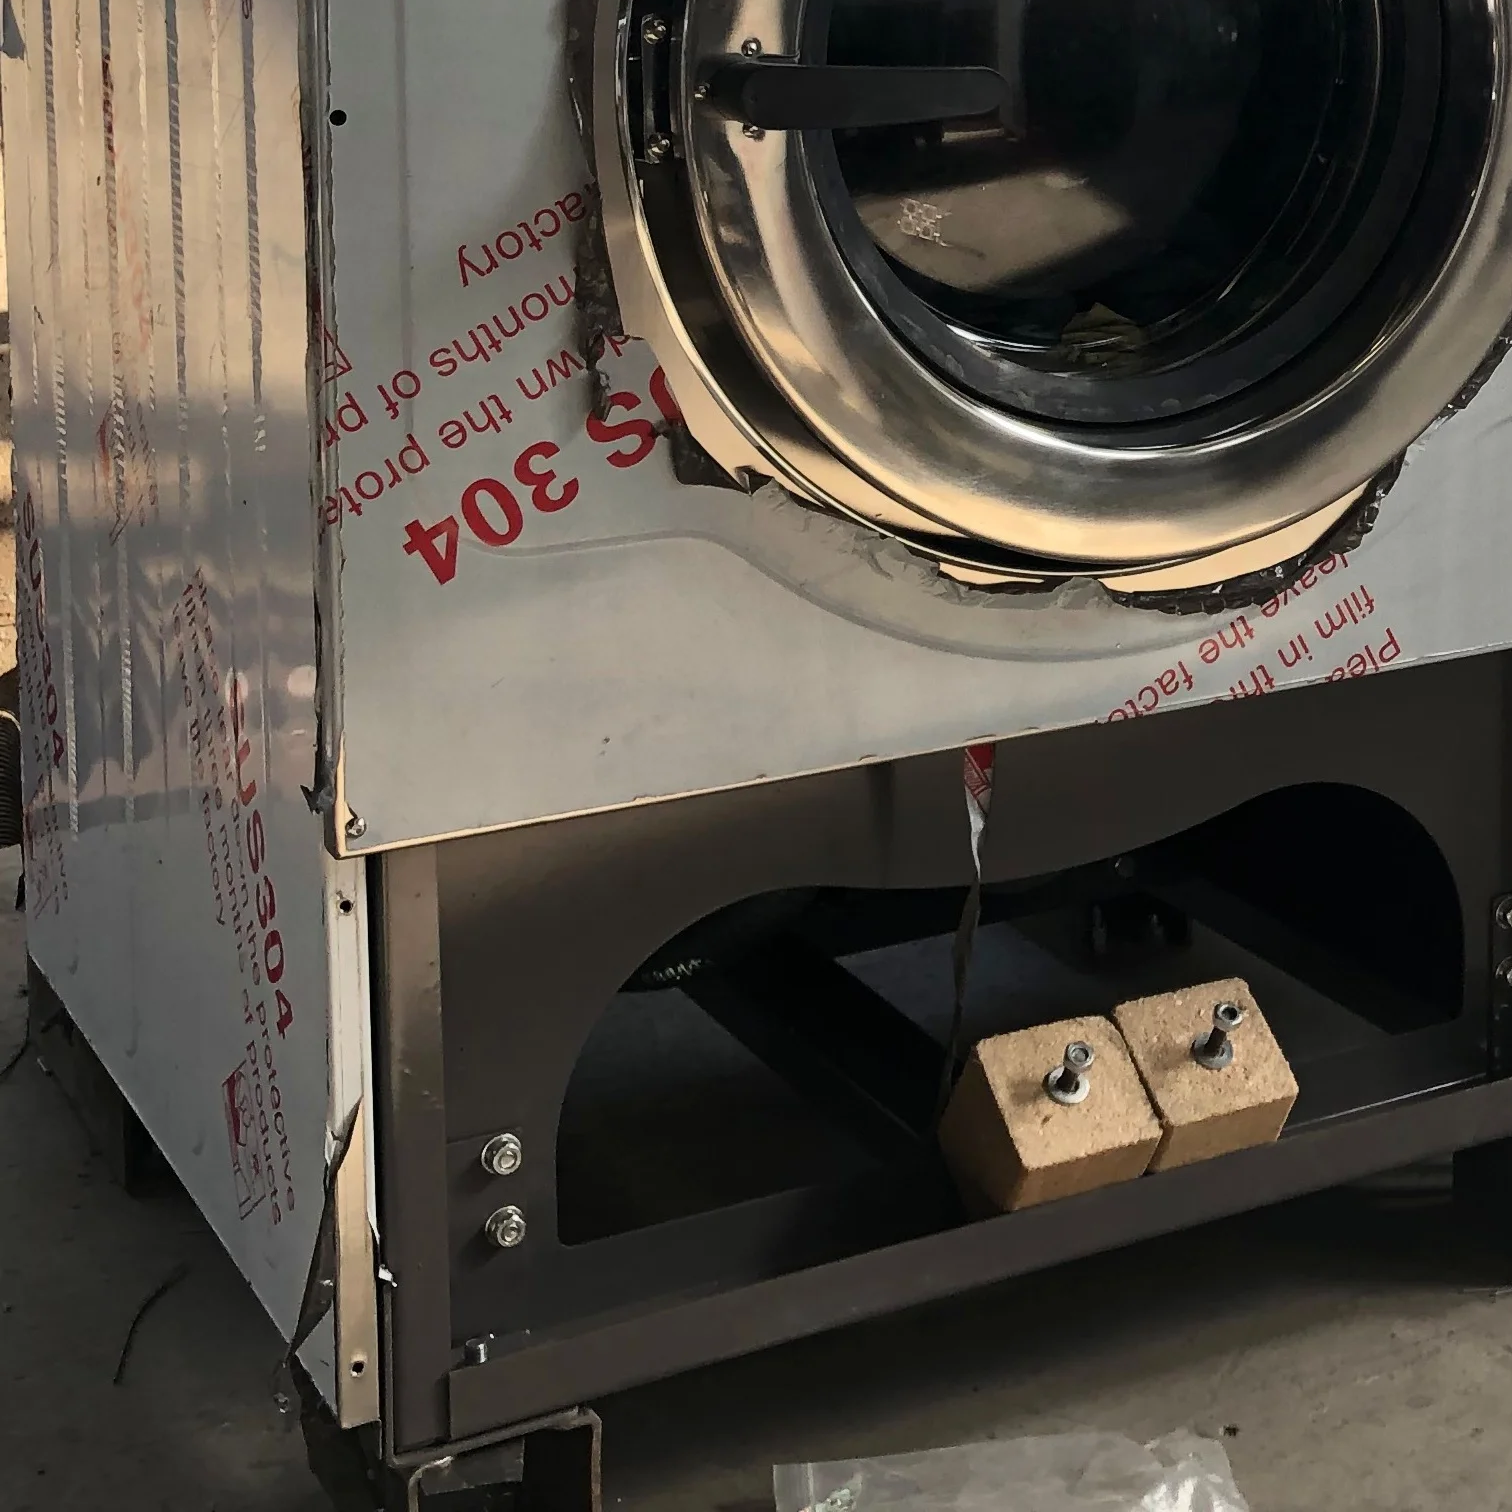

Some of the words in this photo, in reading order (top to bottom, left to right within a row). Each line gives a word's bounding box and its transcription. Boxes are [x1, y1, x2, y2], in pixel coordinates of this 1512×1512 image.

[457, 183, 597, 288] actory
[376, 369, 422, 420] of
[438, 394, 513, 449] the
[402, 440, 580, 586] 304
[1199, 615, 1255, 664] the
[1277, 634, 1313, 668] in
[1314, 584, 1375, 639] film
[1107, 660, 1194, 723] facto
[202, 790, 227, 928] factory
[230, 677, 295, 1040] SUS304
[246, 920, 262, 986] the
[255, 1000, 296, 1212] protective
[246, 1039, 282, 1227] products
